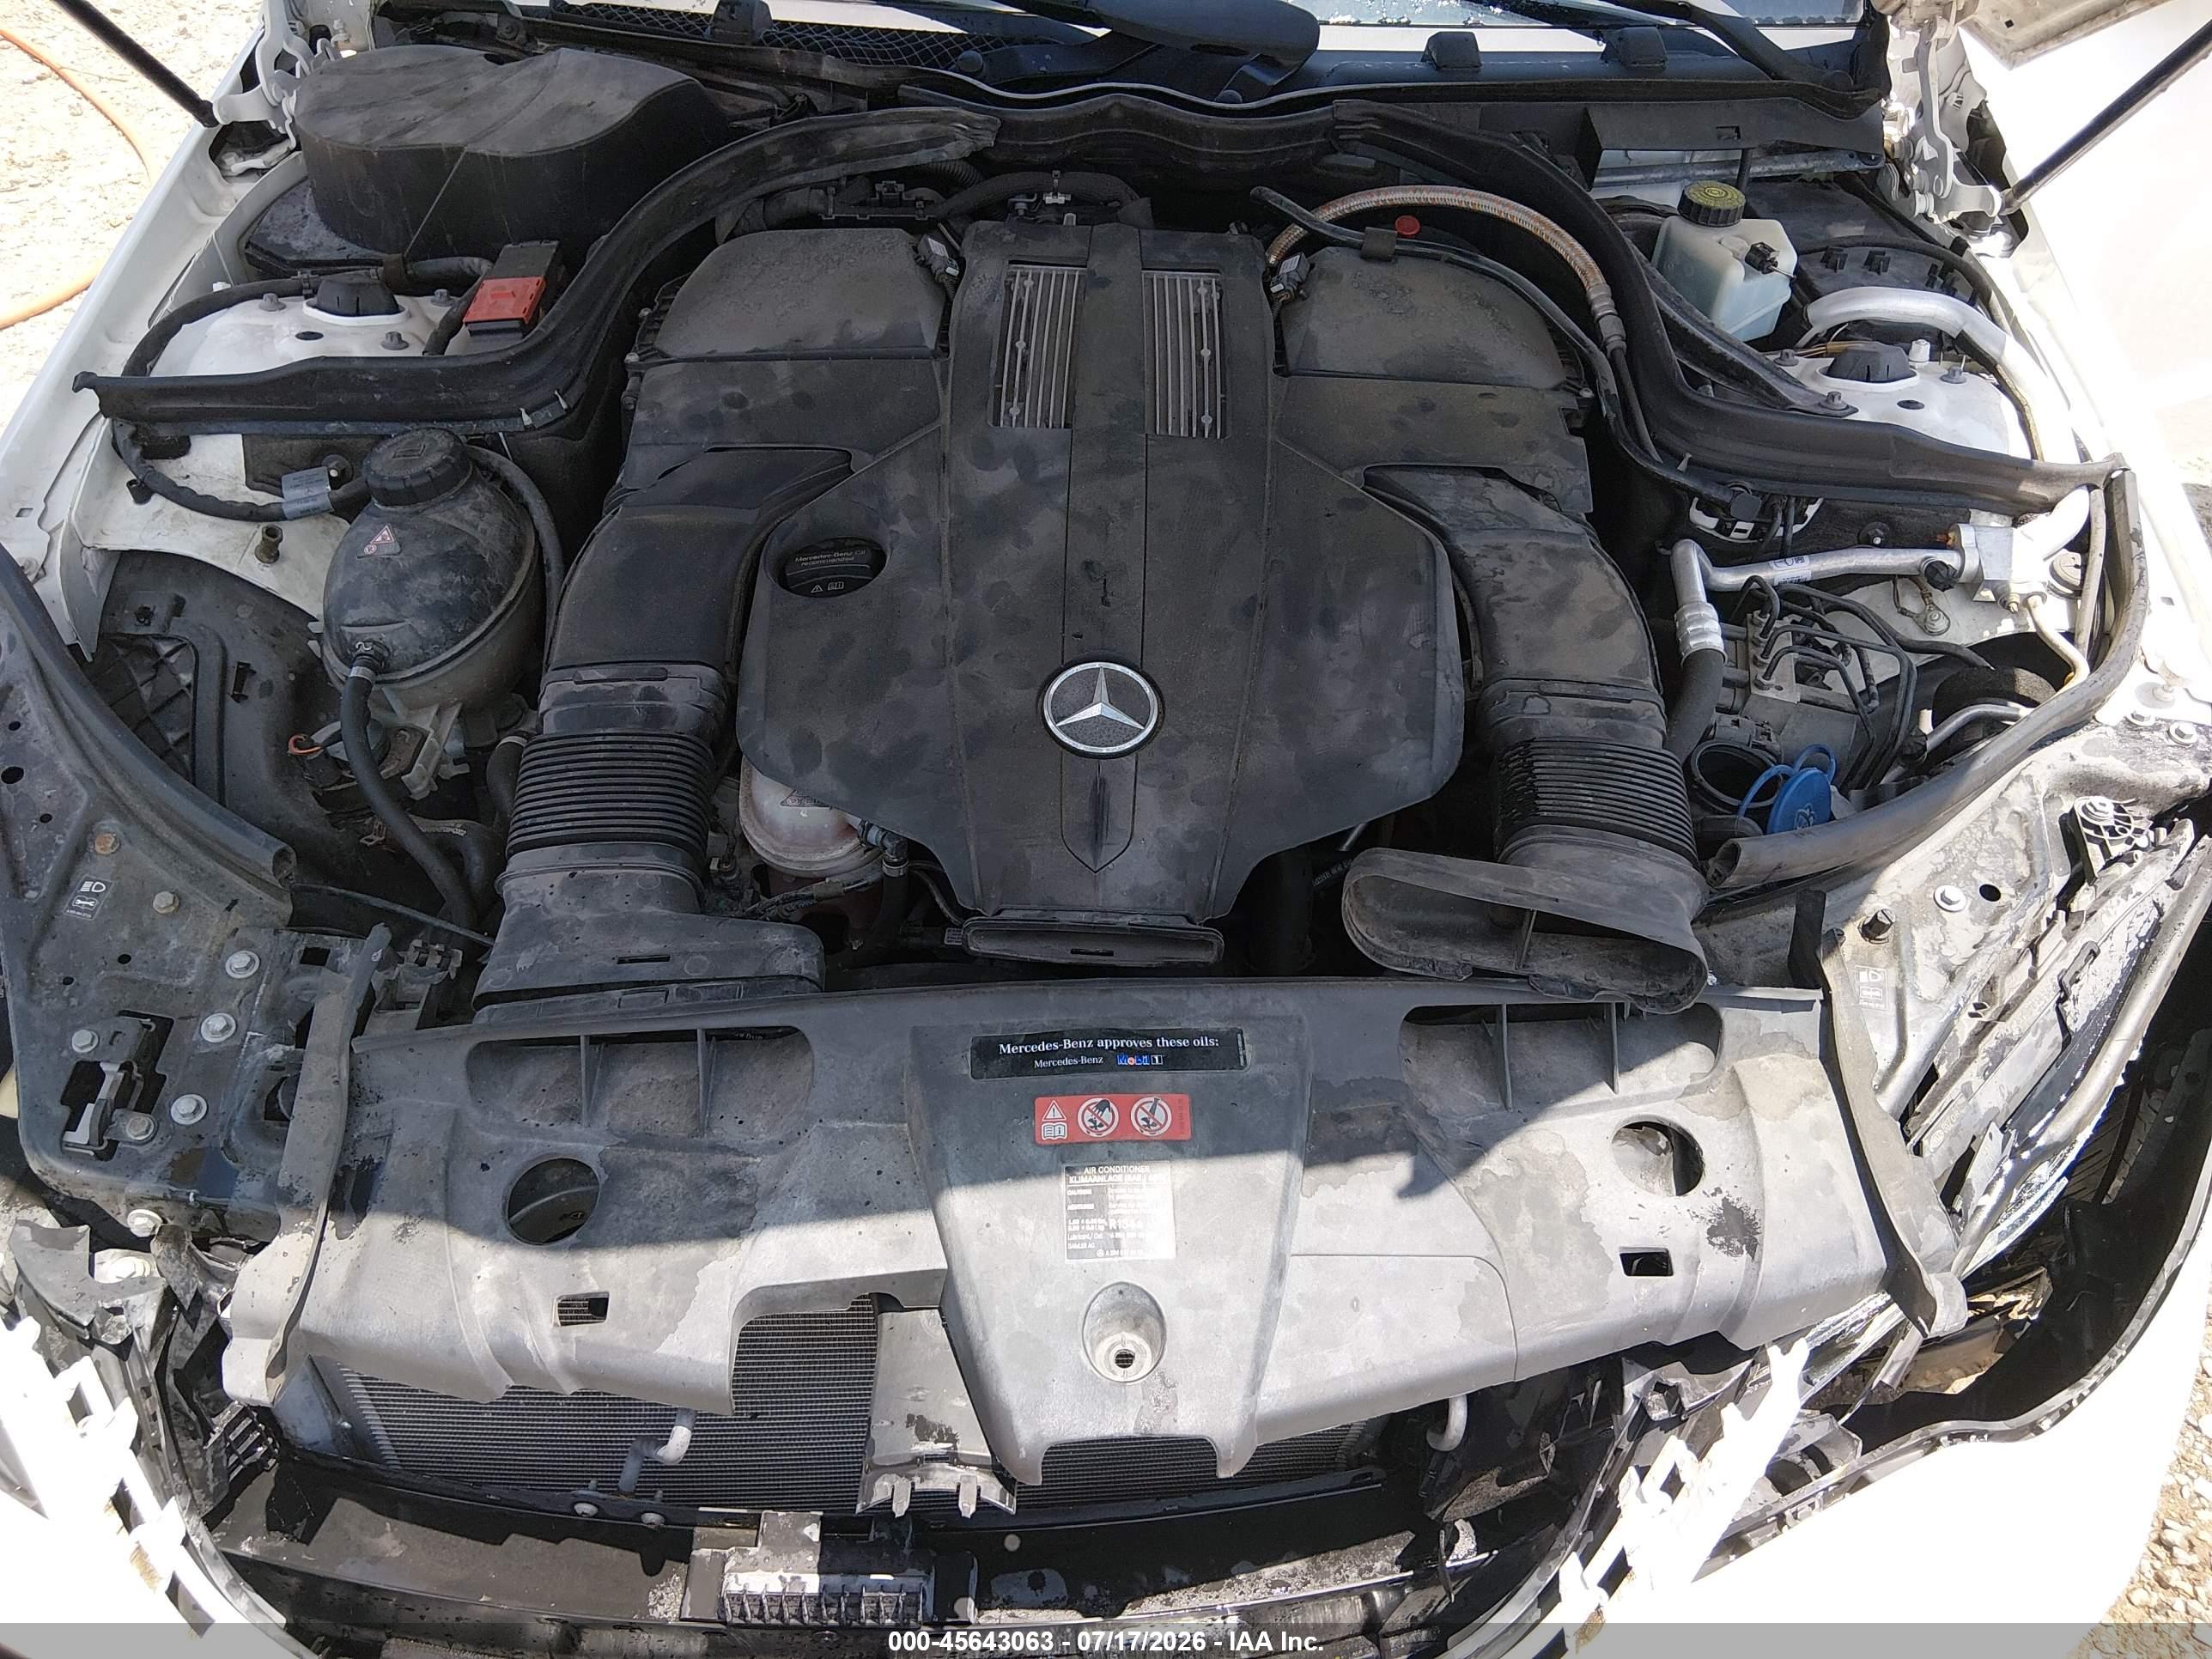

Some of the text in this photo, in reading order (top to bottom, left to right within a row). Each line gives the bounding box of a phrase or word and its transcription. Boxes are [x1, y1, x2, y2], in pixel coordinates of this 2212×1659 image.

[999, 1036, 1219, 1055] Mercedes-Benz approves these oils:
[1034, 1054, 1104, 1069] Mercedes-Benz
[1117, 1054, 1150, 1066] Mobil
[1084, 1164, 1150, 1175] AIR CONDITIONER
